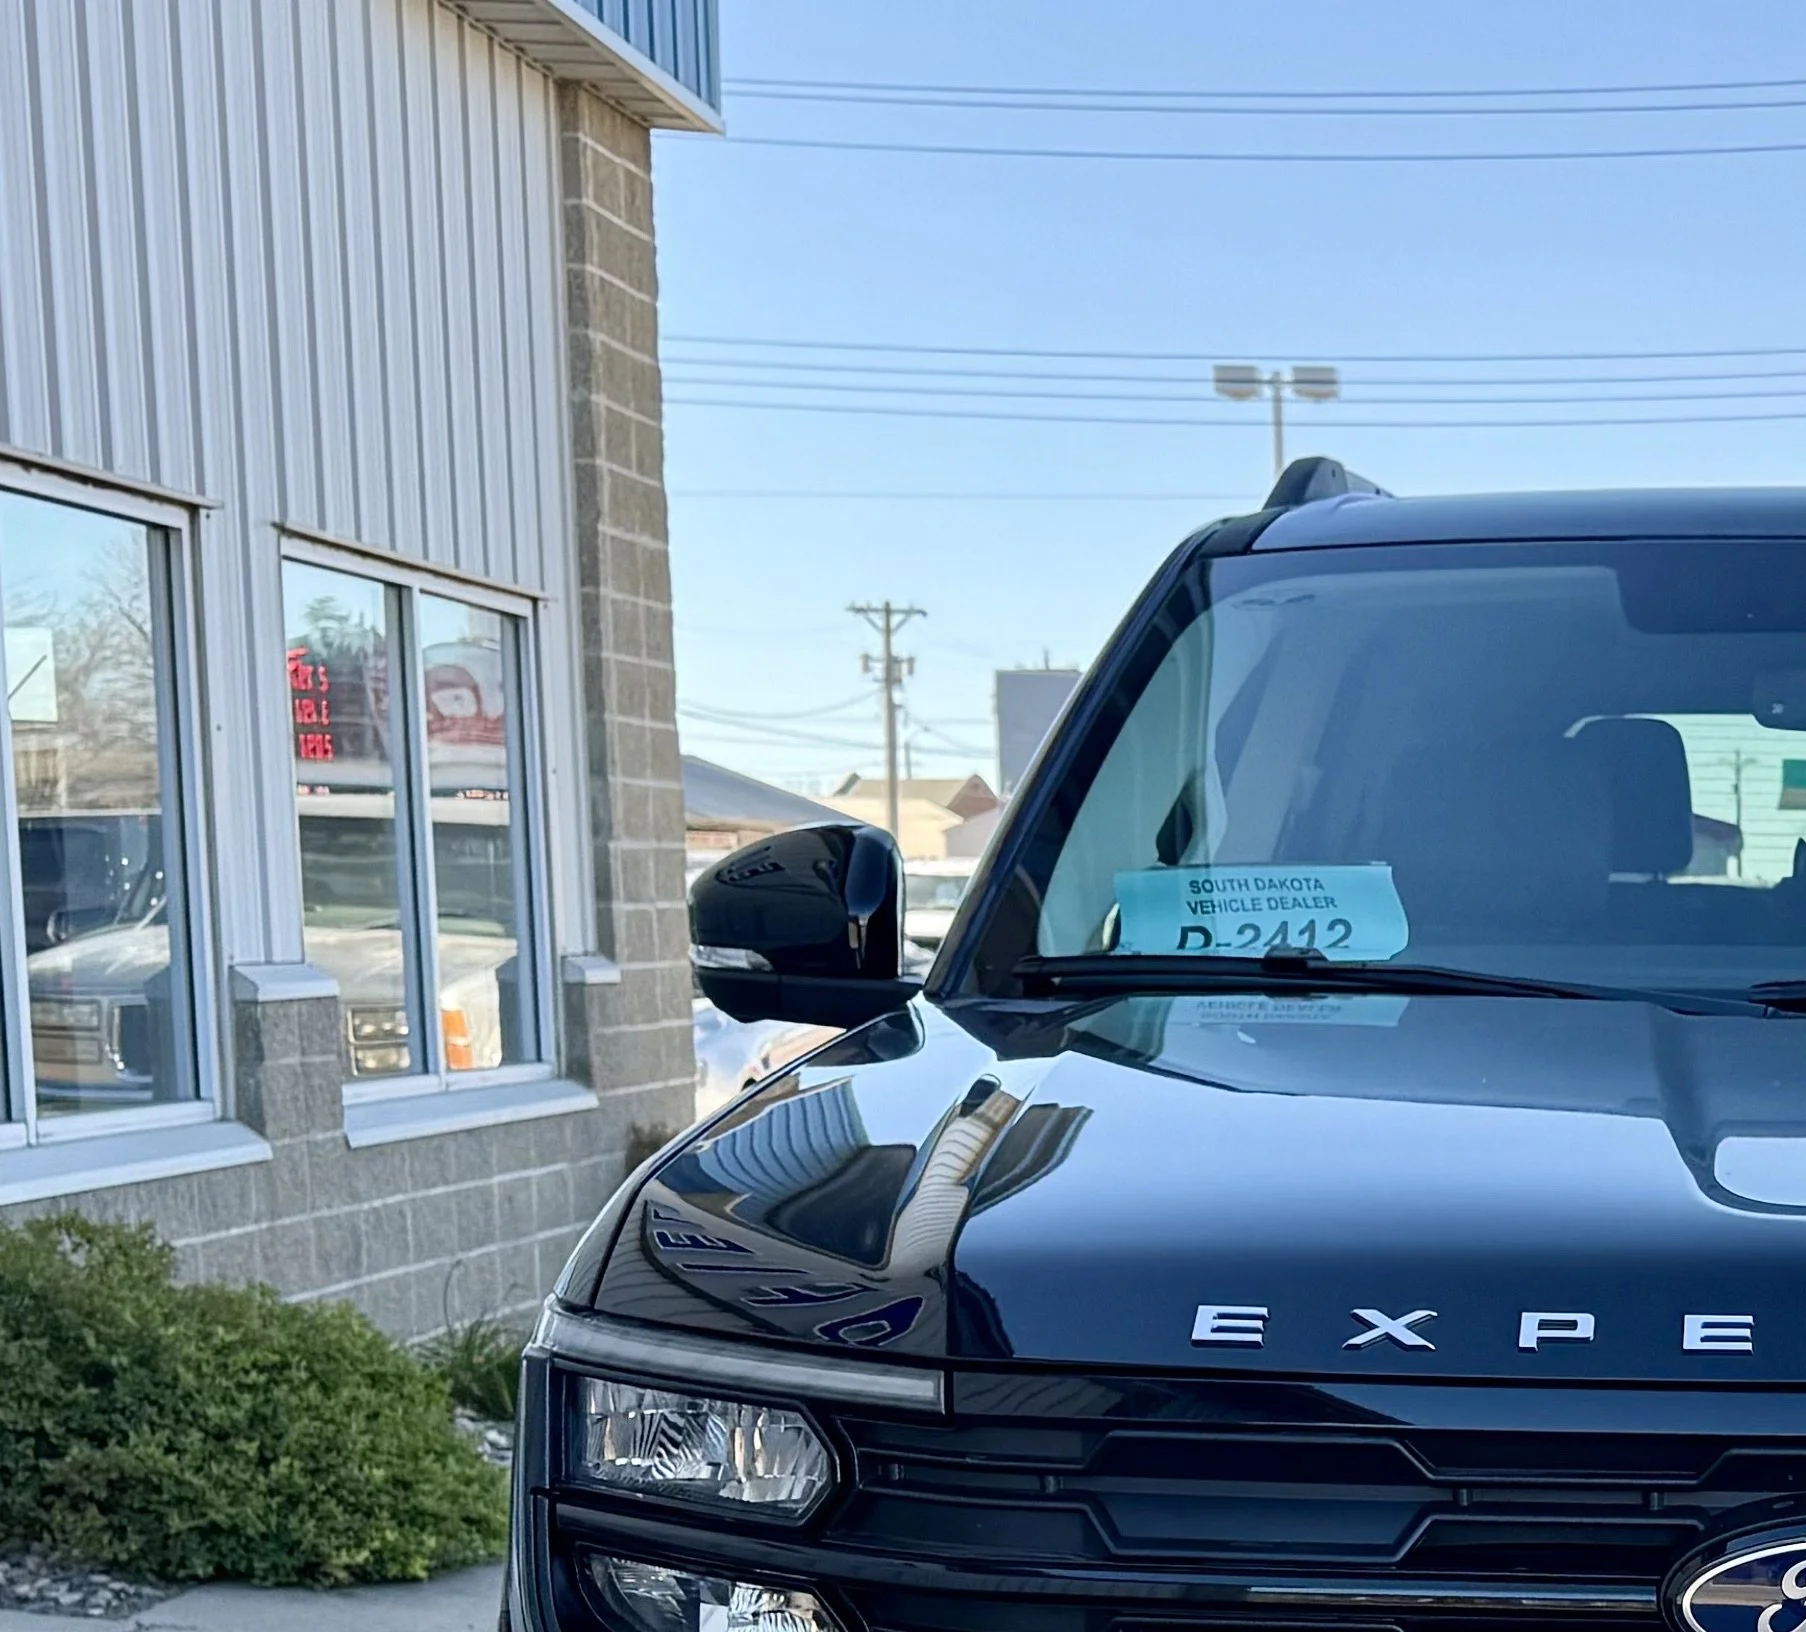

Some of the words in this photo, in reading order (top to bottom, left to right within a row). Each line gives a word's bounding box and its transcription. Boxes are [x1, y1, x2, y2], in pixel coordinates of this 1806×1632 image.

[1188, 878, 1250, 894] SOUTH
[1254, 877, 1325, 892] DAKOTA
[1186, 898, 1263, 915] VEHICLE
[1267, 896, 1338, 911] DEALER
[1176, 918, 1353, 950] D-2412
